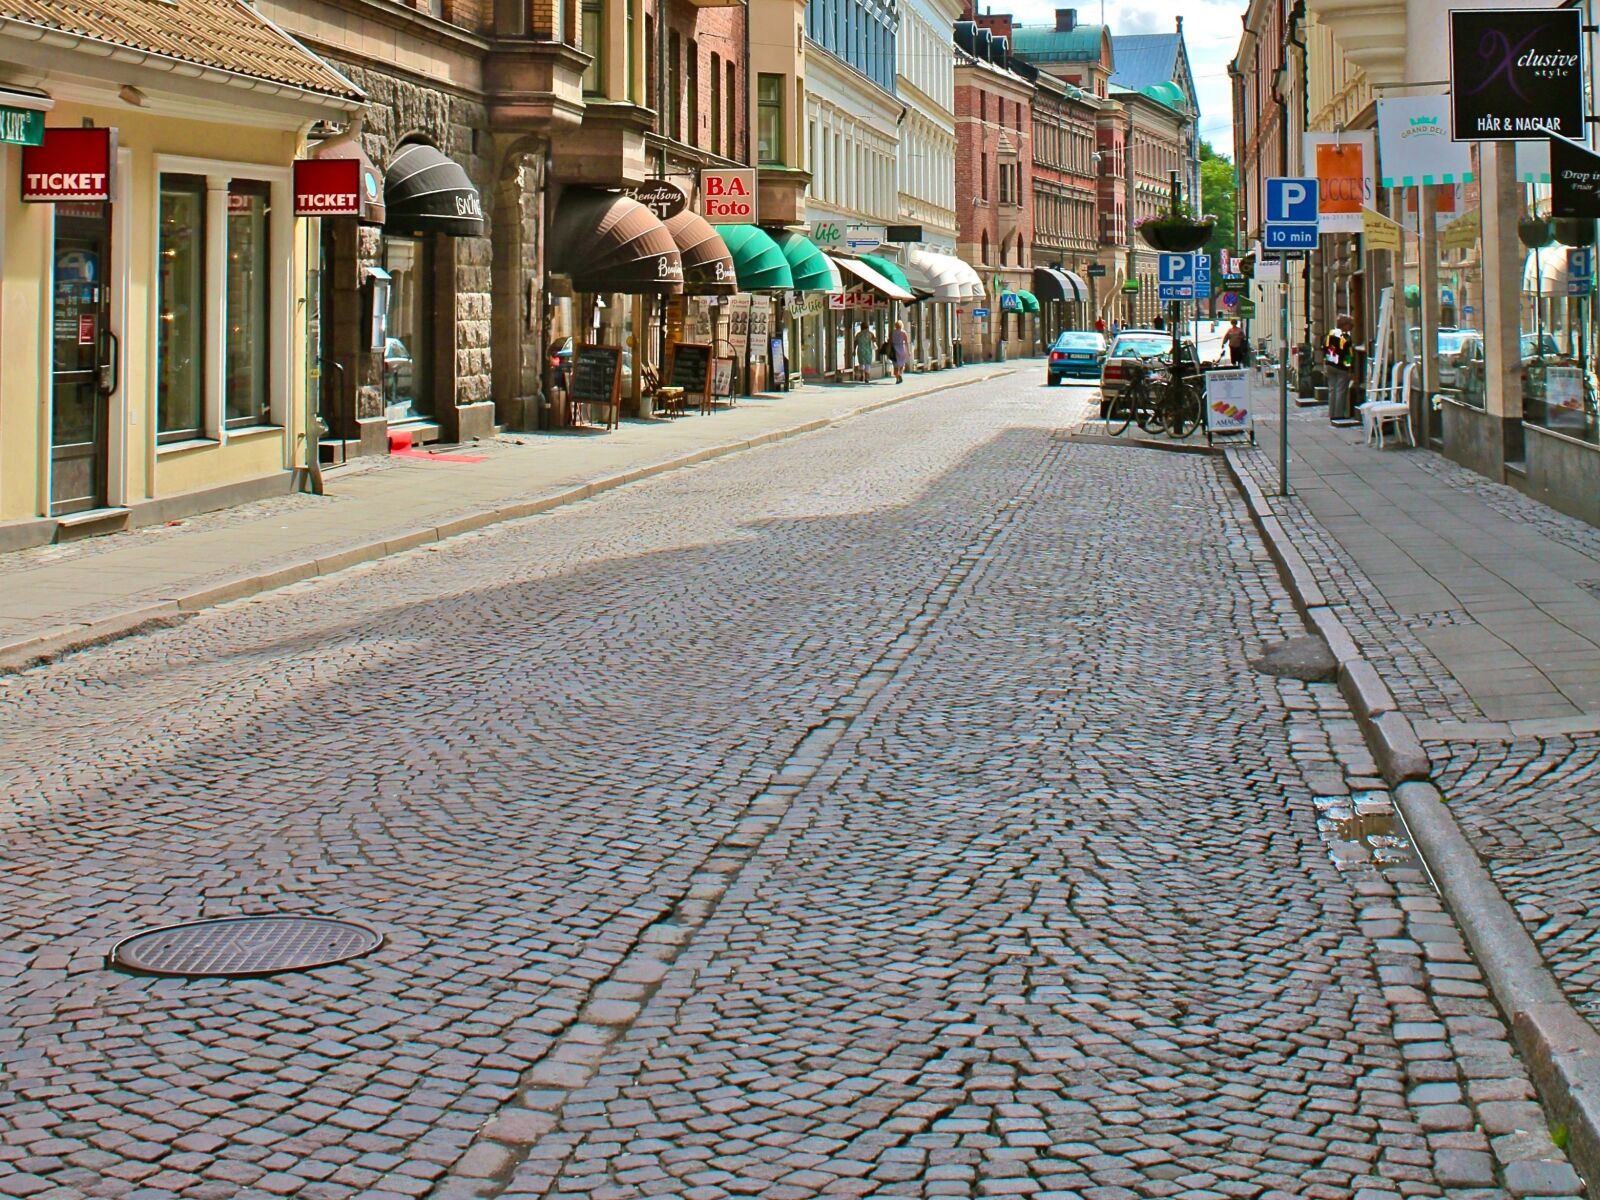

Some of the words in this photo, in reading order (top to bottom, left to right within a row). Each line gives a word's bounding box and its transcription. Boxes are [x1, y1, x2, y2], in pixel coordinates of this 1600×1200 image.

[1535, 68, 1569, 78] style
[1477, 113, 1501, 131] HÅR
[1503, 117, 1513, 131] &
[1515, 117, 1561, 131] NAGLAR
[1401, 126, 1427, 138] GRAND
[1429, 126, 1448, 136] DELI
[27, 173, 106, 190] TICKET
[1562, 170, 1590, 183] Drop
[706, 177, 750, 196] B.A.
[1319, 177, 1371, 201] UCCESS
[297, 193, 357, 207] TICKET
[705, 199, 751, 216] Foto
[1281, 182, 1306, 218] P
[648, 202, 671, 218] ST
[815, 222, 841, 243] life
[1272, 231, 1286, 242] 10
[1291, 231, 1312, 242] min
[1168, 256, 1186, 280] P
[1199, 256, 1207, 267] P
